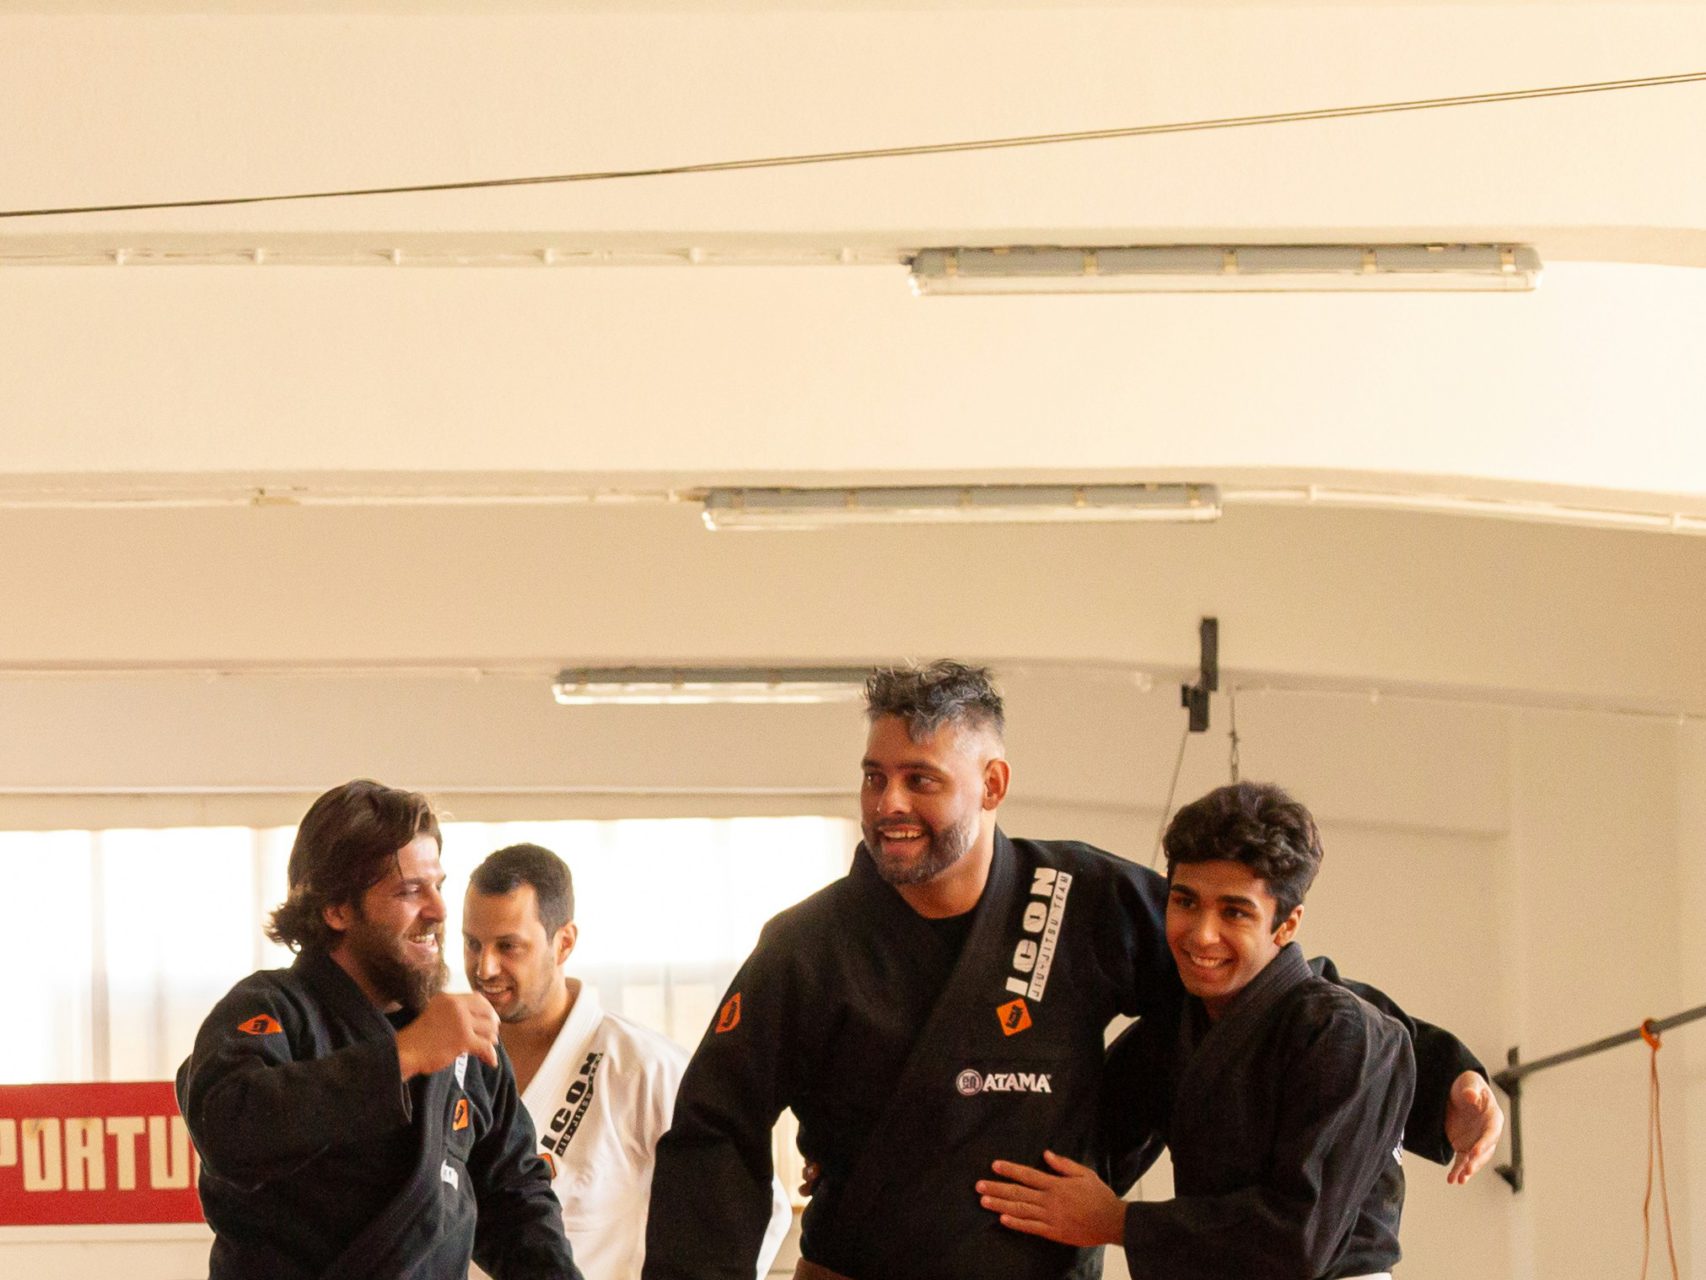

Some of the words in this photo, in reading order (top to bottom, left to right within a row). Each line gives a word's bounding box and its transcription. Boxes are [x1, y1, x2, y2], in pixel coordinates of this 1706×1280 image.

[1005, 867, 1057, 997] ICON
[1031, 918, 1058, 998] JIU-JITSU
[541, 1052, 598, 1150] ICON
[982, 1073, 1052, 1093] ATAMA
[0, 1116, 201, 1192] ORTU
